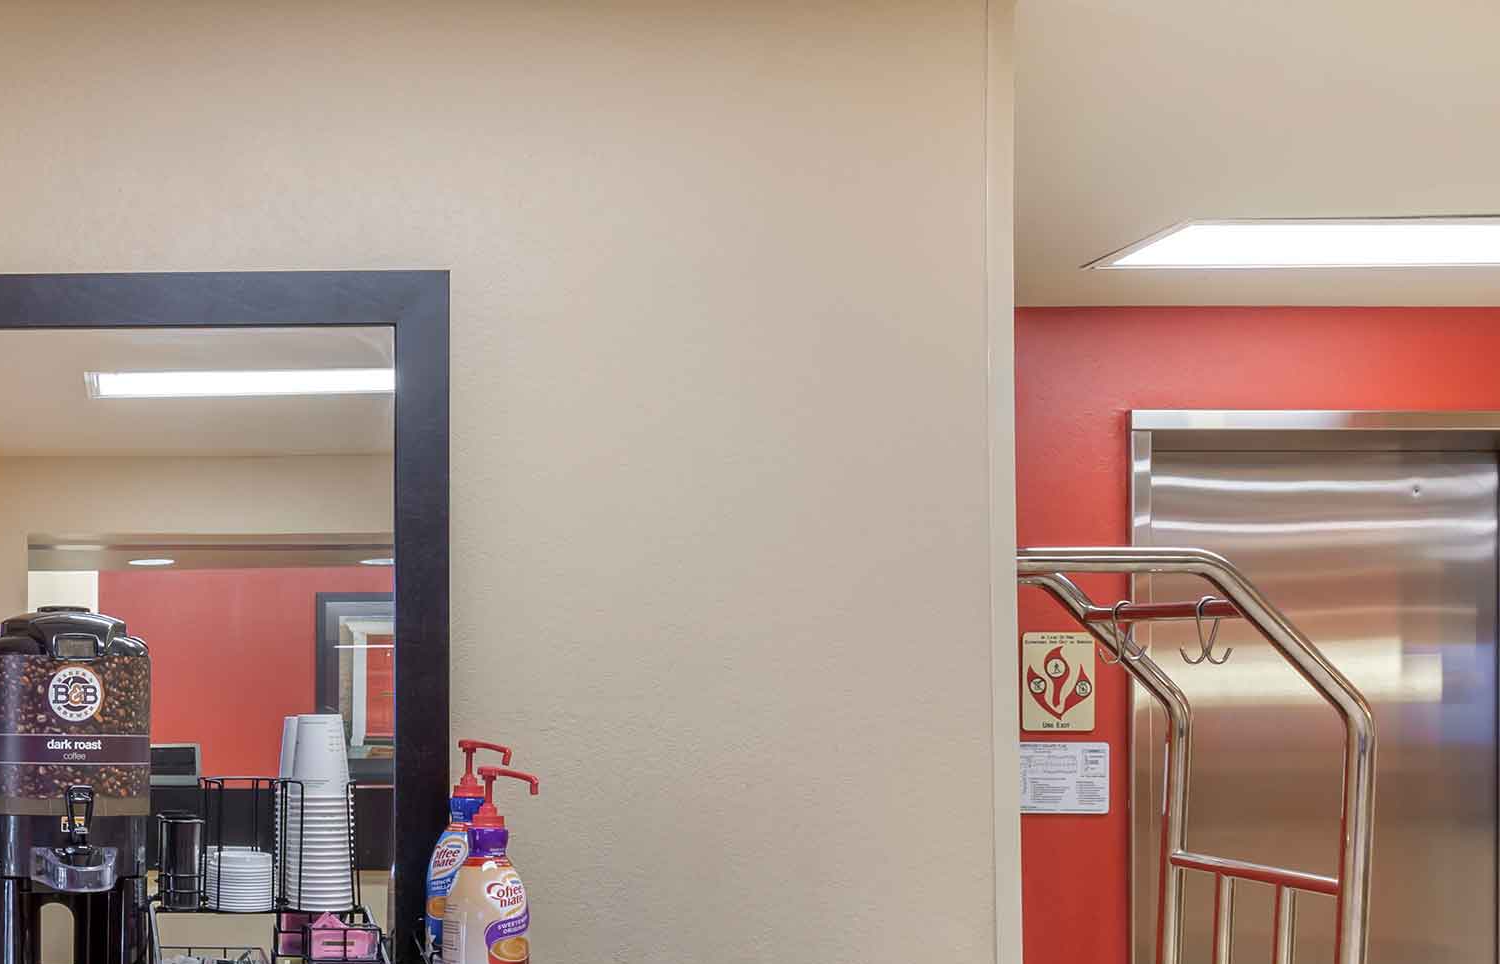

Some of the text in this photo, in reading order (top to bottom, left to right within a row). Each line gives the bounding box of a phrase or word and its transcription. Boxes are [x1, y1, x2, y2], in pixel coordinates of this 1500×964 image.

[52, 684, 99, 705] B&B
[47, 739, 102, 750] dark roast
[63, 752, 86, 760] coffee
